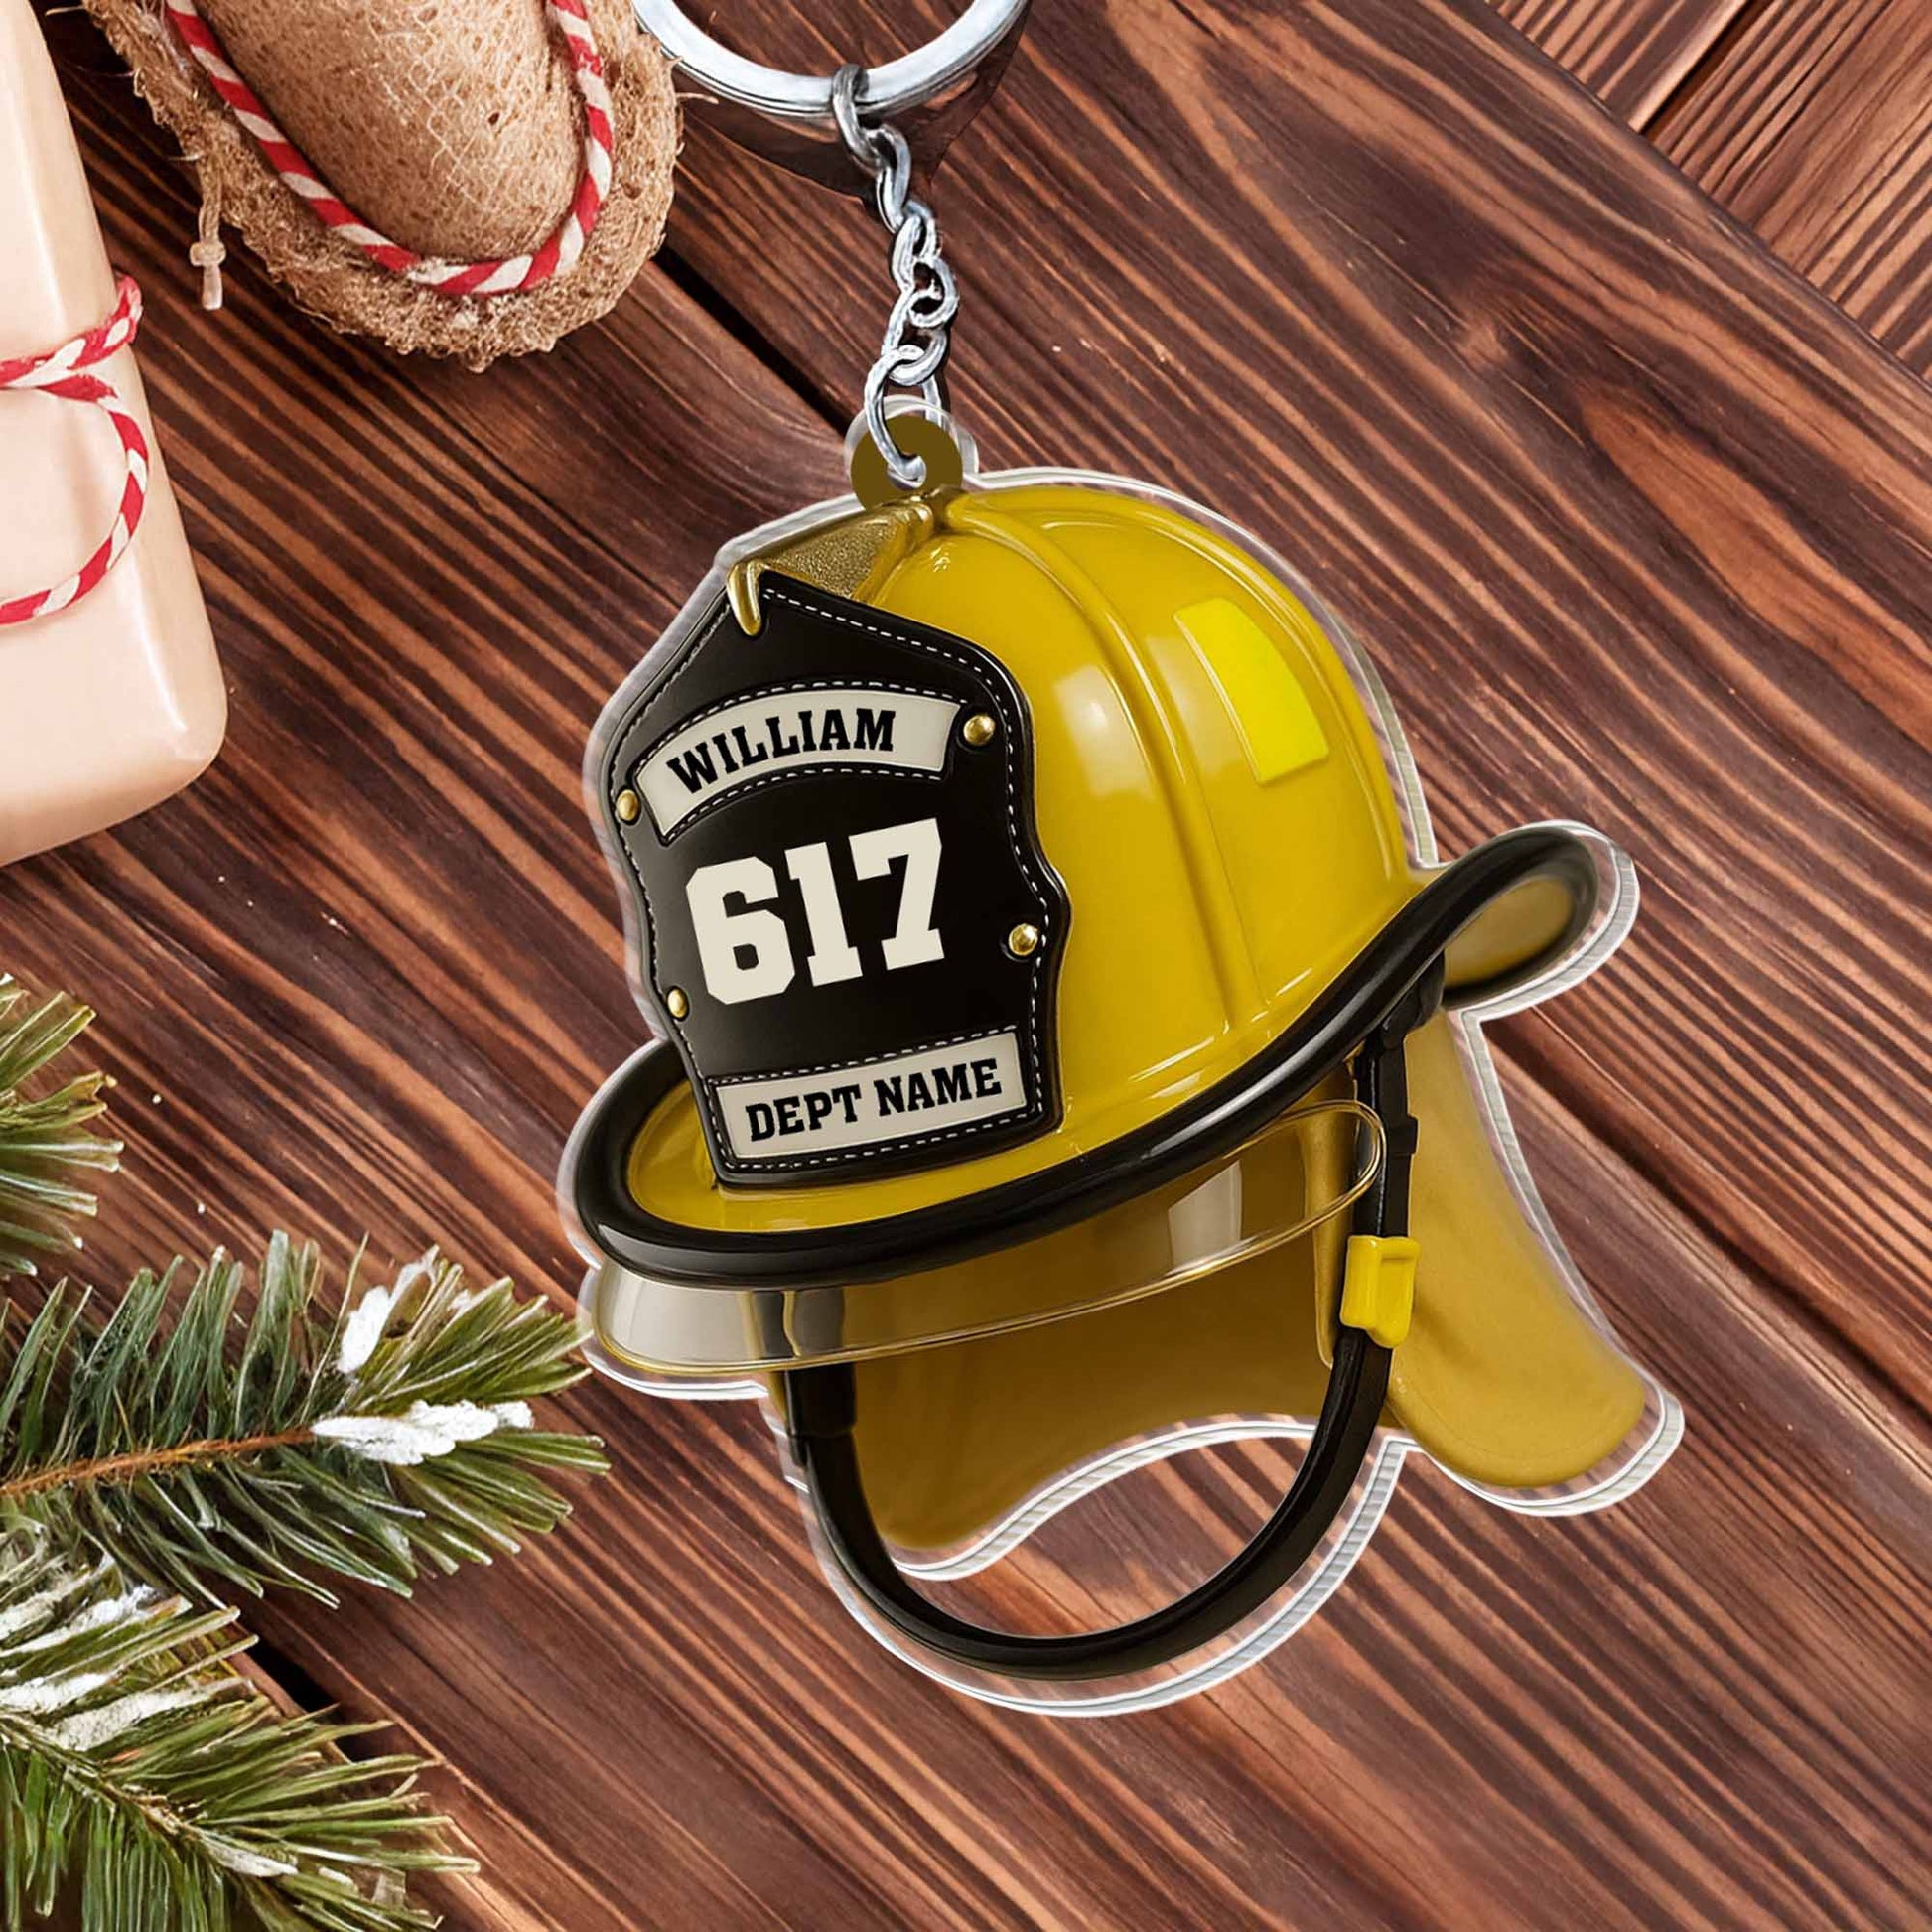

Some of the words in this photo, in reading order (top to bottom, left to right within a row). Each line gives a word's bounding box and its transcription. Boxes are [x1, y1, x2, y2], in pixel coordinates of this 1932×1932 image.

[666, 708, 896, 794] WILLIAM
[686, 818, 945, 1005] 617
[746, 1086, 862, 1142] DEPT
[874, 1058, 1002, 1117] NAME
